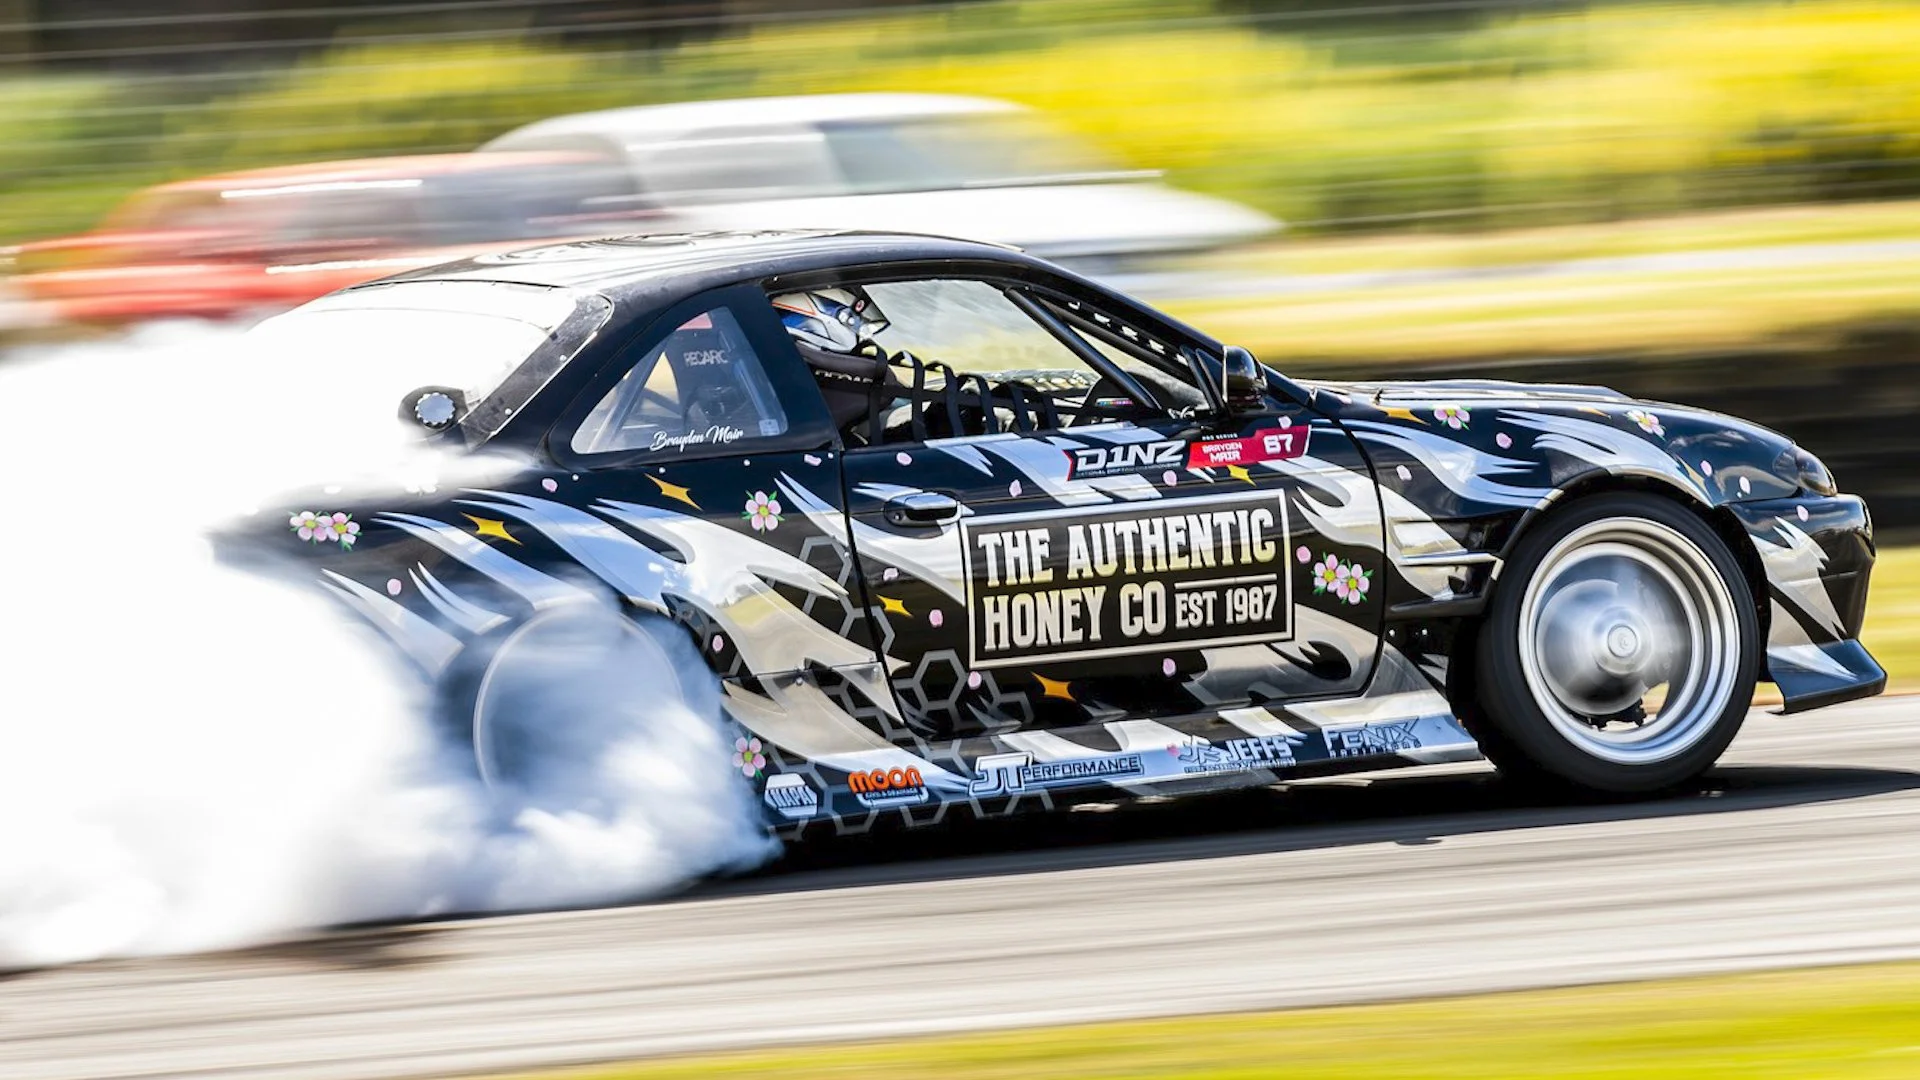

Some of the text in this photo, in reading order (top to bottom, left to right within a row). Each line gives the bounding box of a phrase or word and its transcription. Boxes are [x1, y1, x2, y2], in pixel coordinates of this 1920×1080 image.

[650, 429, 704, 452] Brayden
[706, 425, 744, 444] Mair
[1202, 441, 1243, 454] BRAYDEN
[1074, 439, 1187, 472] D1NZ
[1209, 450, 1241, 463] MAIR
[978, 508, 1277, 587] THE AUTHENTIC
[983, 580, 1279, 651] HONEY CO EST 1987
[1225, 736, 1293, 761] JEFFS
[1023, 756, 1140, 781] PERFORMANCE
[768, 785, 818, 808] NAPA
